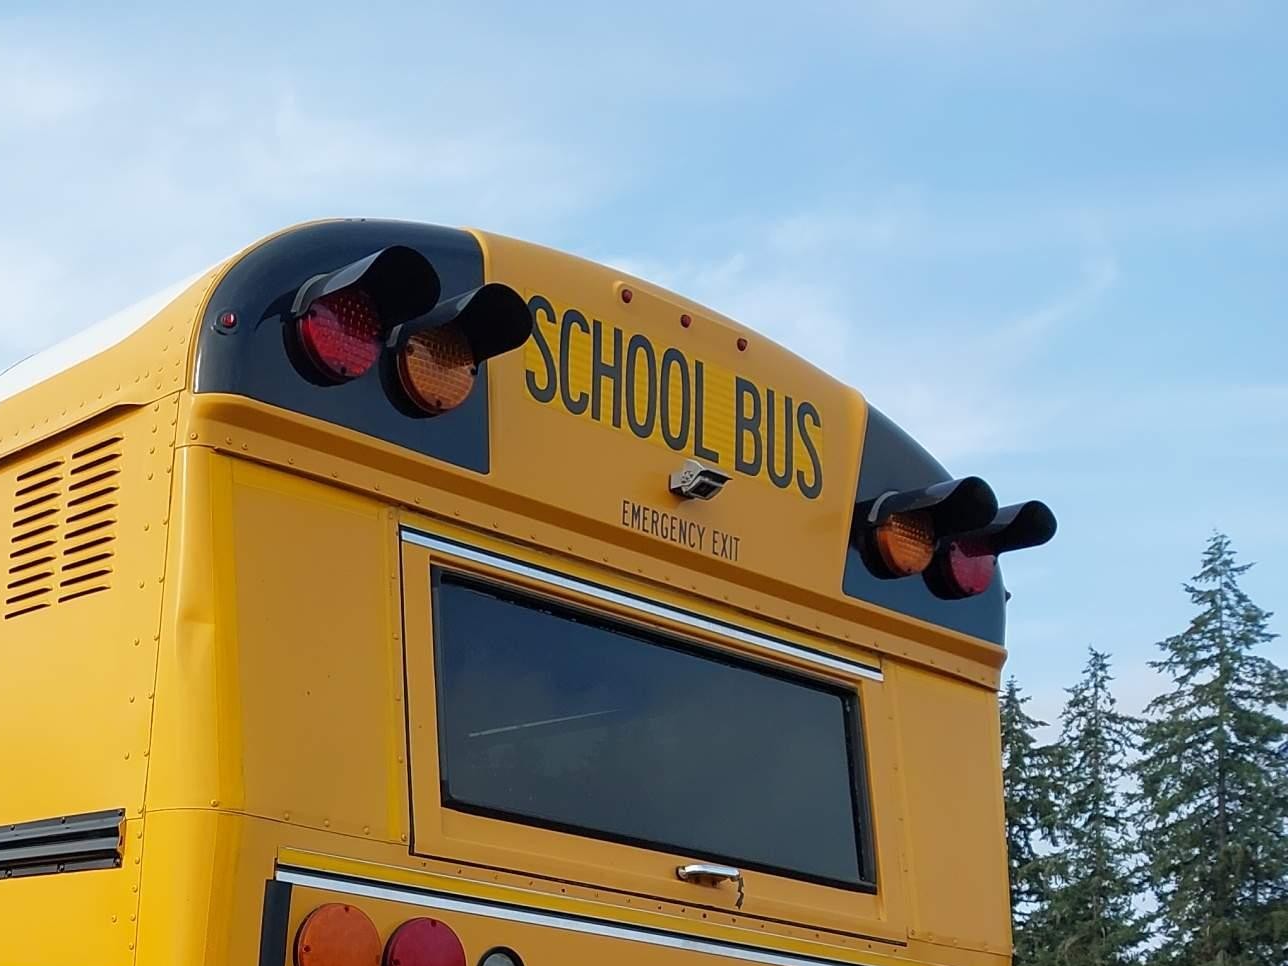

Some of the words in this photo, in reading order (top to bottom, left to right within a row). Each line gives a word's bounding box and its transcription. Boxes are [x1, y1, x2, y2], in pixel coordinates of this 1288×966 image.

[525, 295, 719, 463] SCHOOL
[735, 375, 823, 499] BUS
[622, 500, 706, 551] EMERGENCY
[712, 529, 740, 561] EXIT
